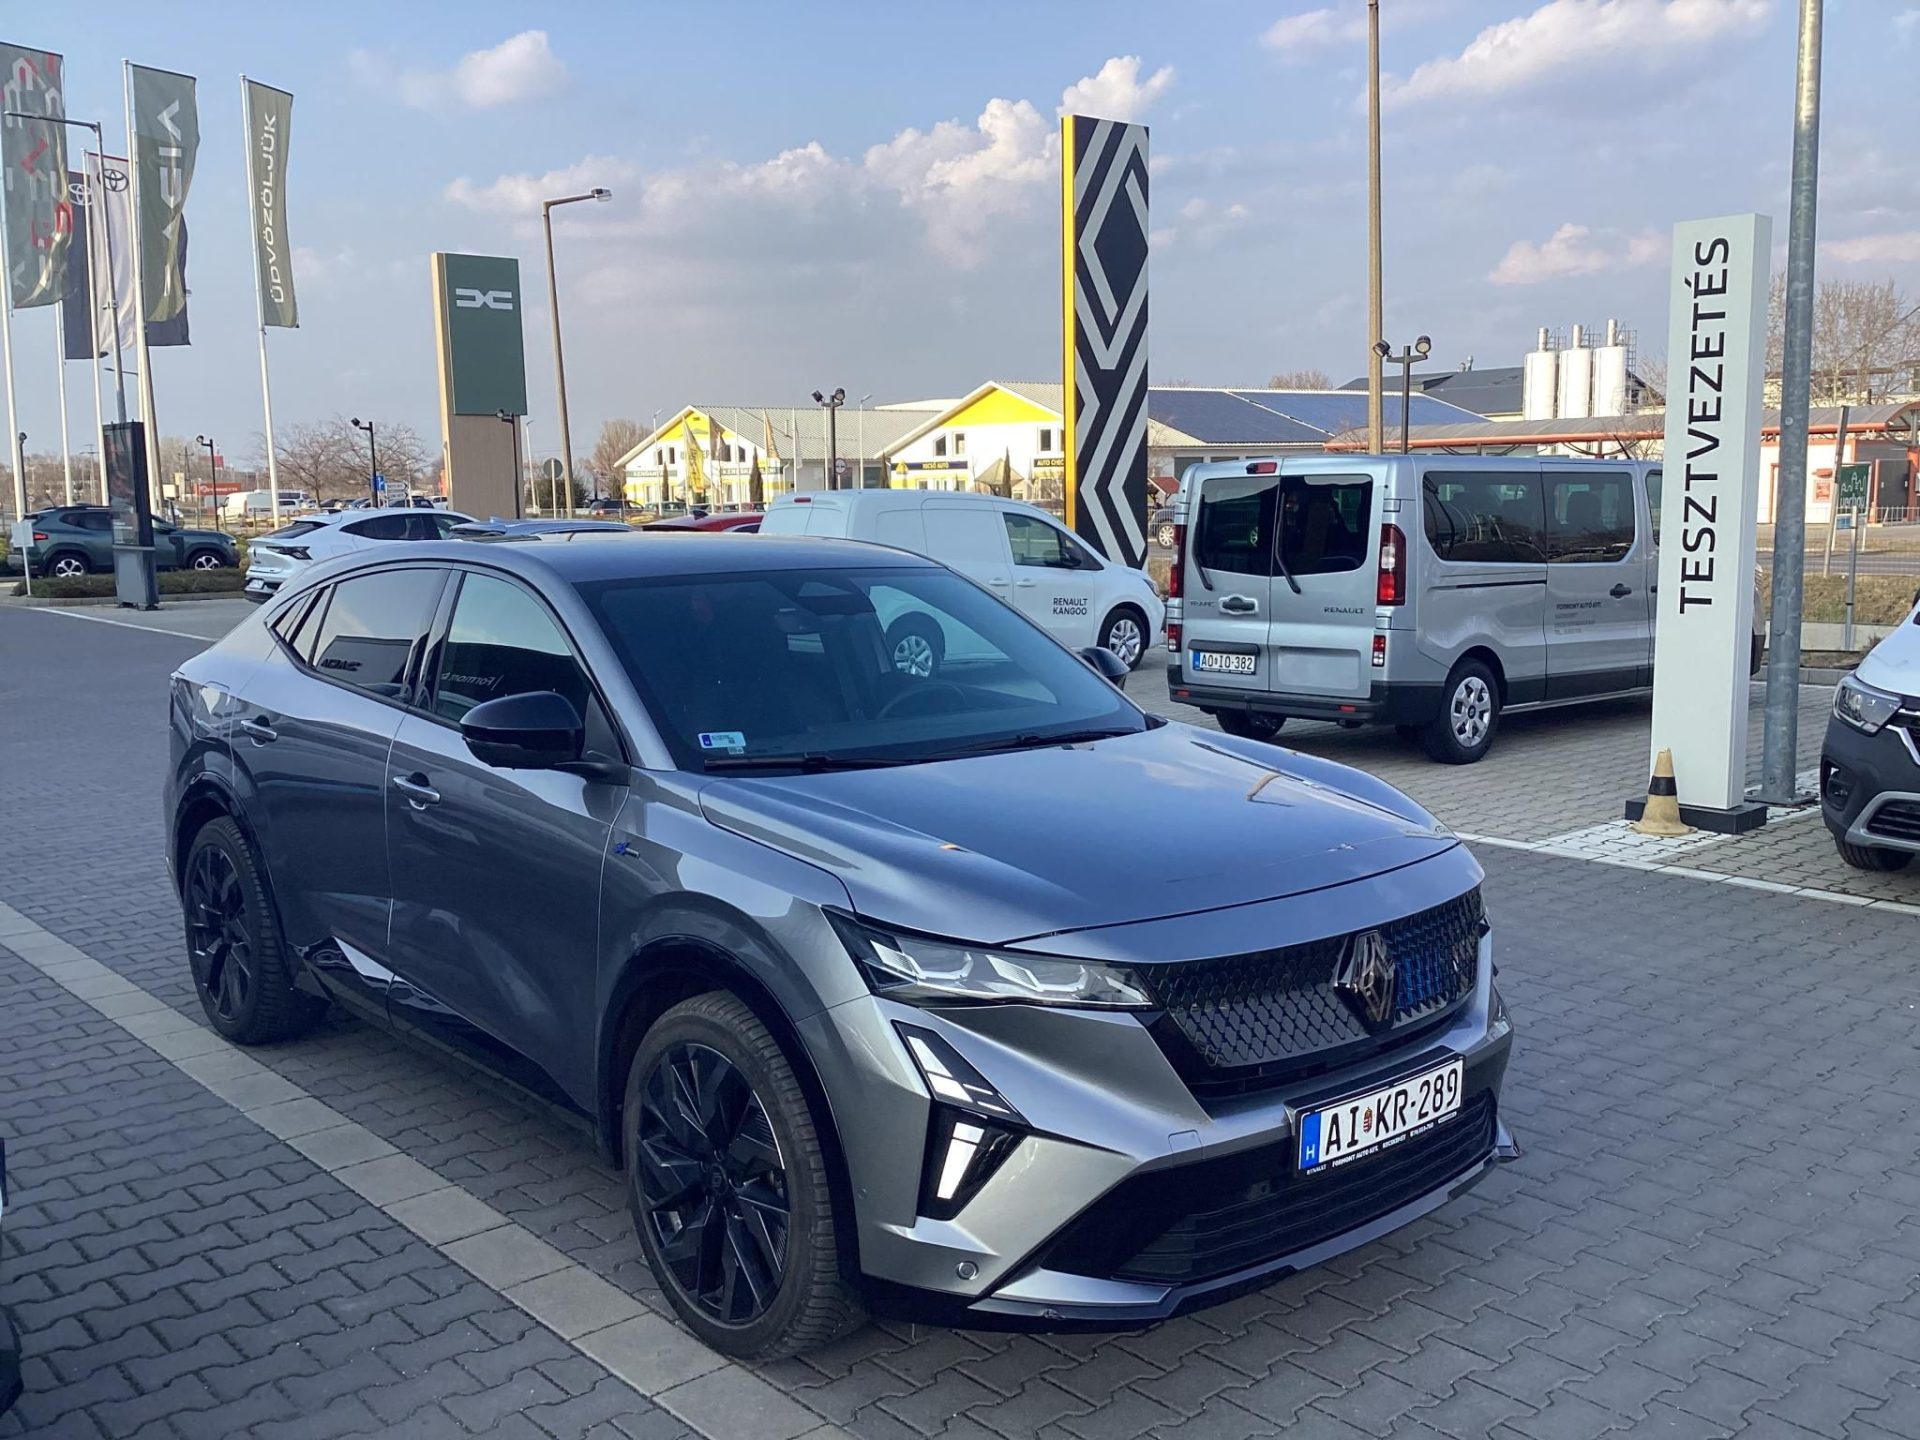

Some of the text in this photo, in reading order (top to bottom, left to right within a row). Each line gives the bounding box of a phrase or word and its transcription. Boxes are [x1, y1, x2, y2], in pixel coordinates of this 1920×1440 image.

[260, 112, 285, 304] ÜDVÖZÖLJÜK
[1679, 236, 1730, 615] TESZTVEZETÉS
[1052, 597, 1088, 606] RENAULT
[1052, 607, 1088, 615] KANGOO
[1323, 606, 1366, 614] RENAULT
[1305, 1143, 1316, 1161] H
